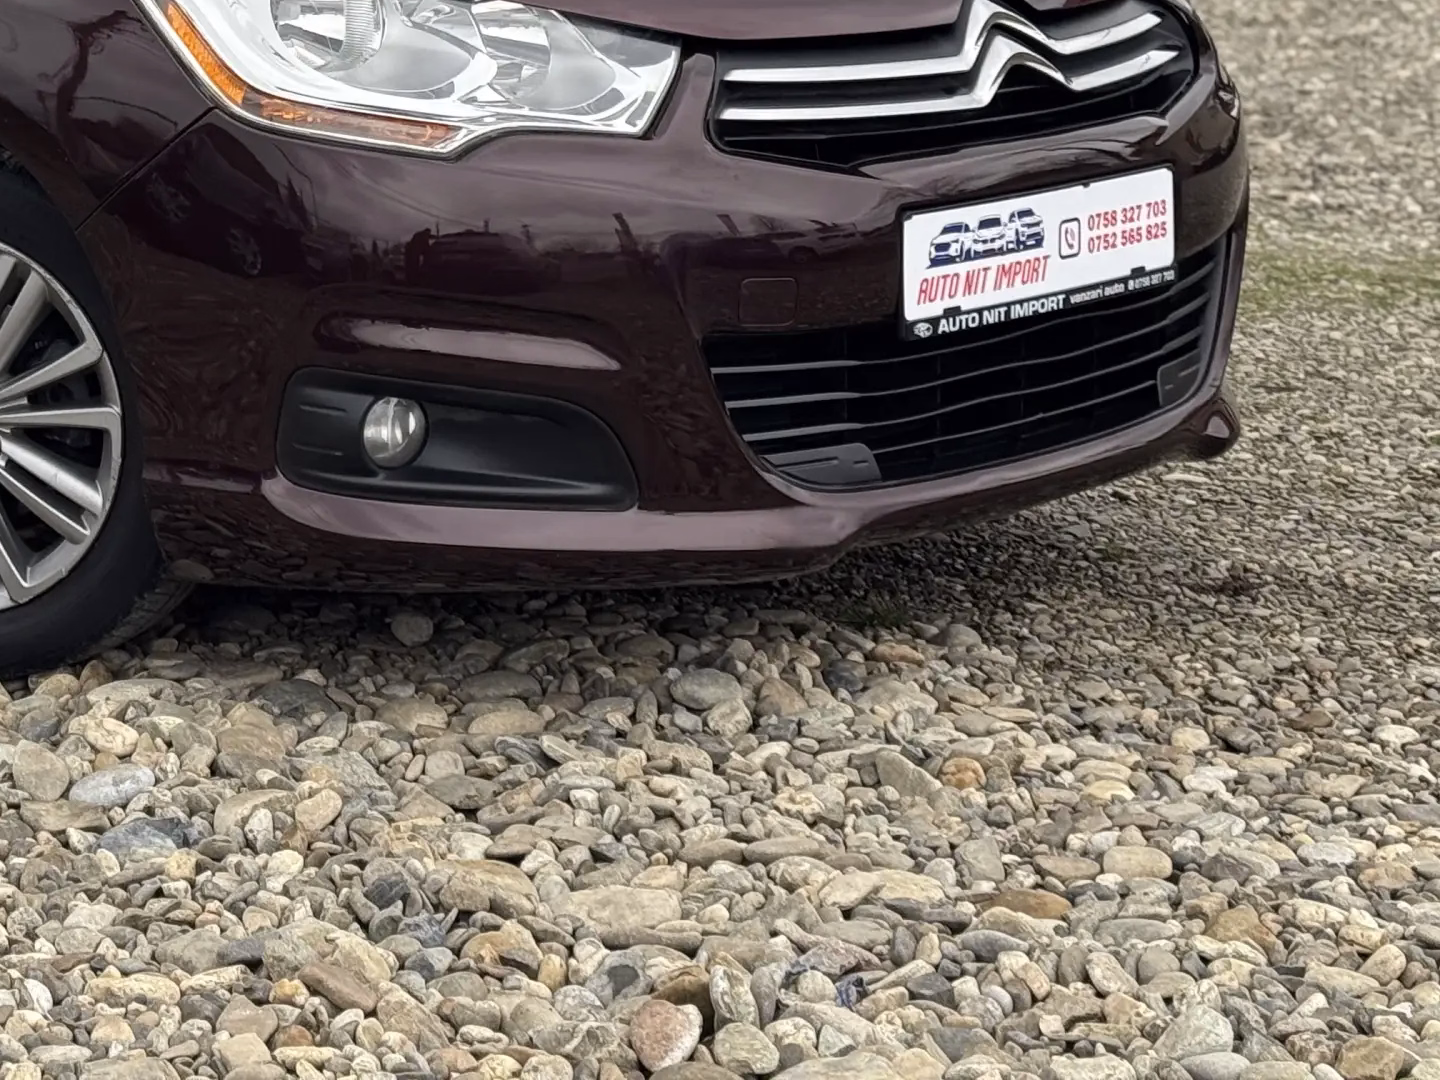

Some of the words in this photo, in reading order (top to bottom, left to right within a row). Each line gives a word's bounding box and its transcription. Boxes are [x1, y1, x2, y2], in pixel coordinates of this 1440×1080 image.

[1087, 210, 1117, 231] 0758
[1120, 205, 1142, 224] 327
[1146, 199, 1167, 219] 703
[1087, 232, 1117, 254] 0752
[1121, 226, 1142, 246] 565
[1146, 221, 1167, 241] 825
[917, 272, 960, 305] AUTO
[962, 267, 992, 298] NIT
[993, 254, 1051, 291] IMPORT
[937, 312, 980, 335] AUTO
[982, 306, 1008, 325] NIT
[1010, 294, 1067, 320] IMPORT
[1104, 282, 1125, 297] auto
